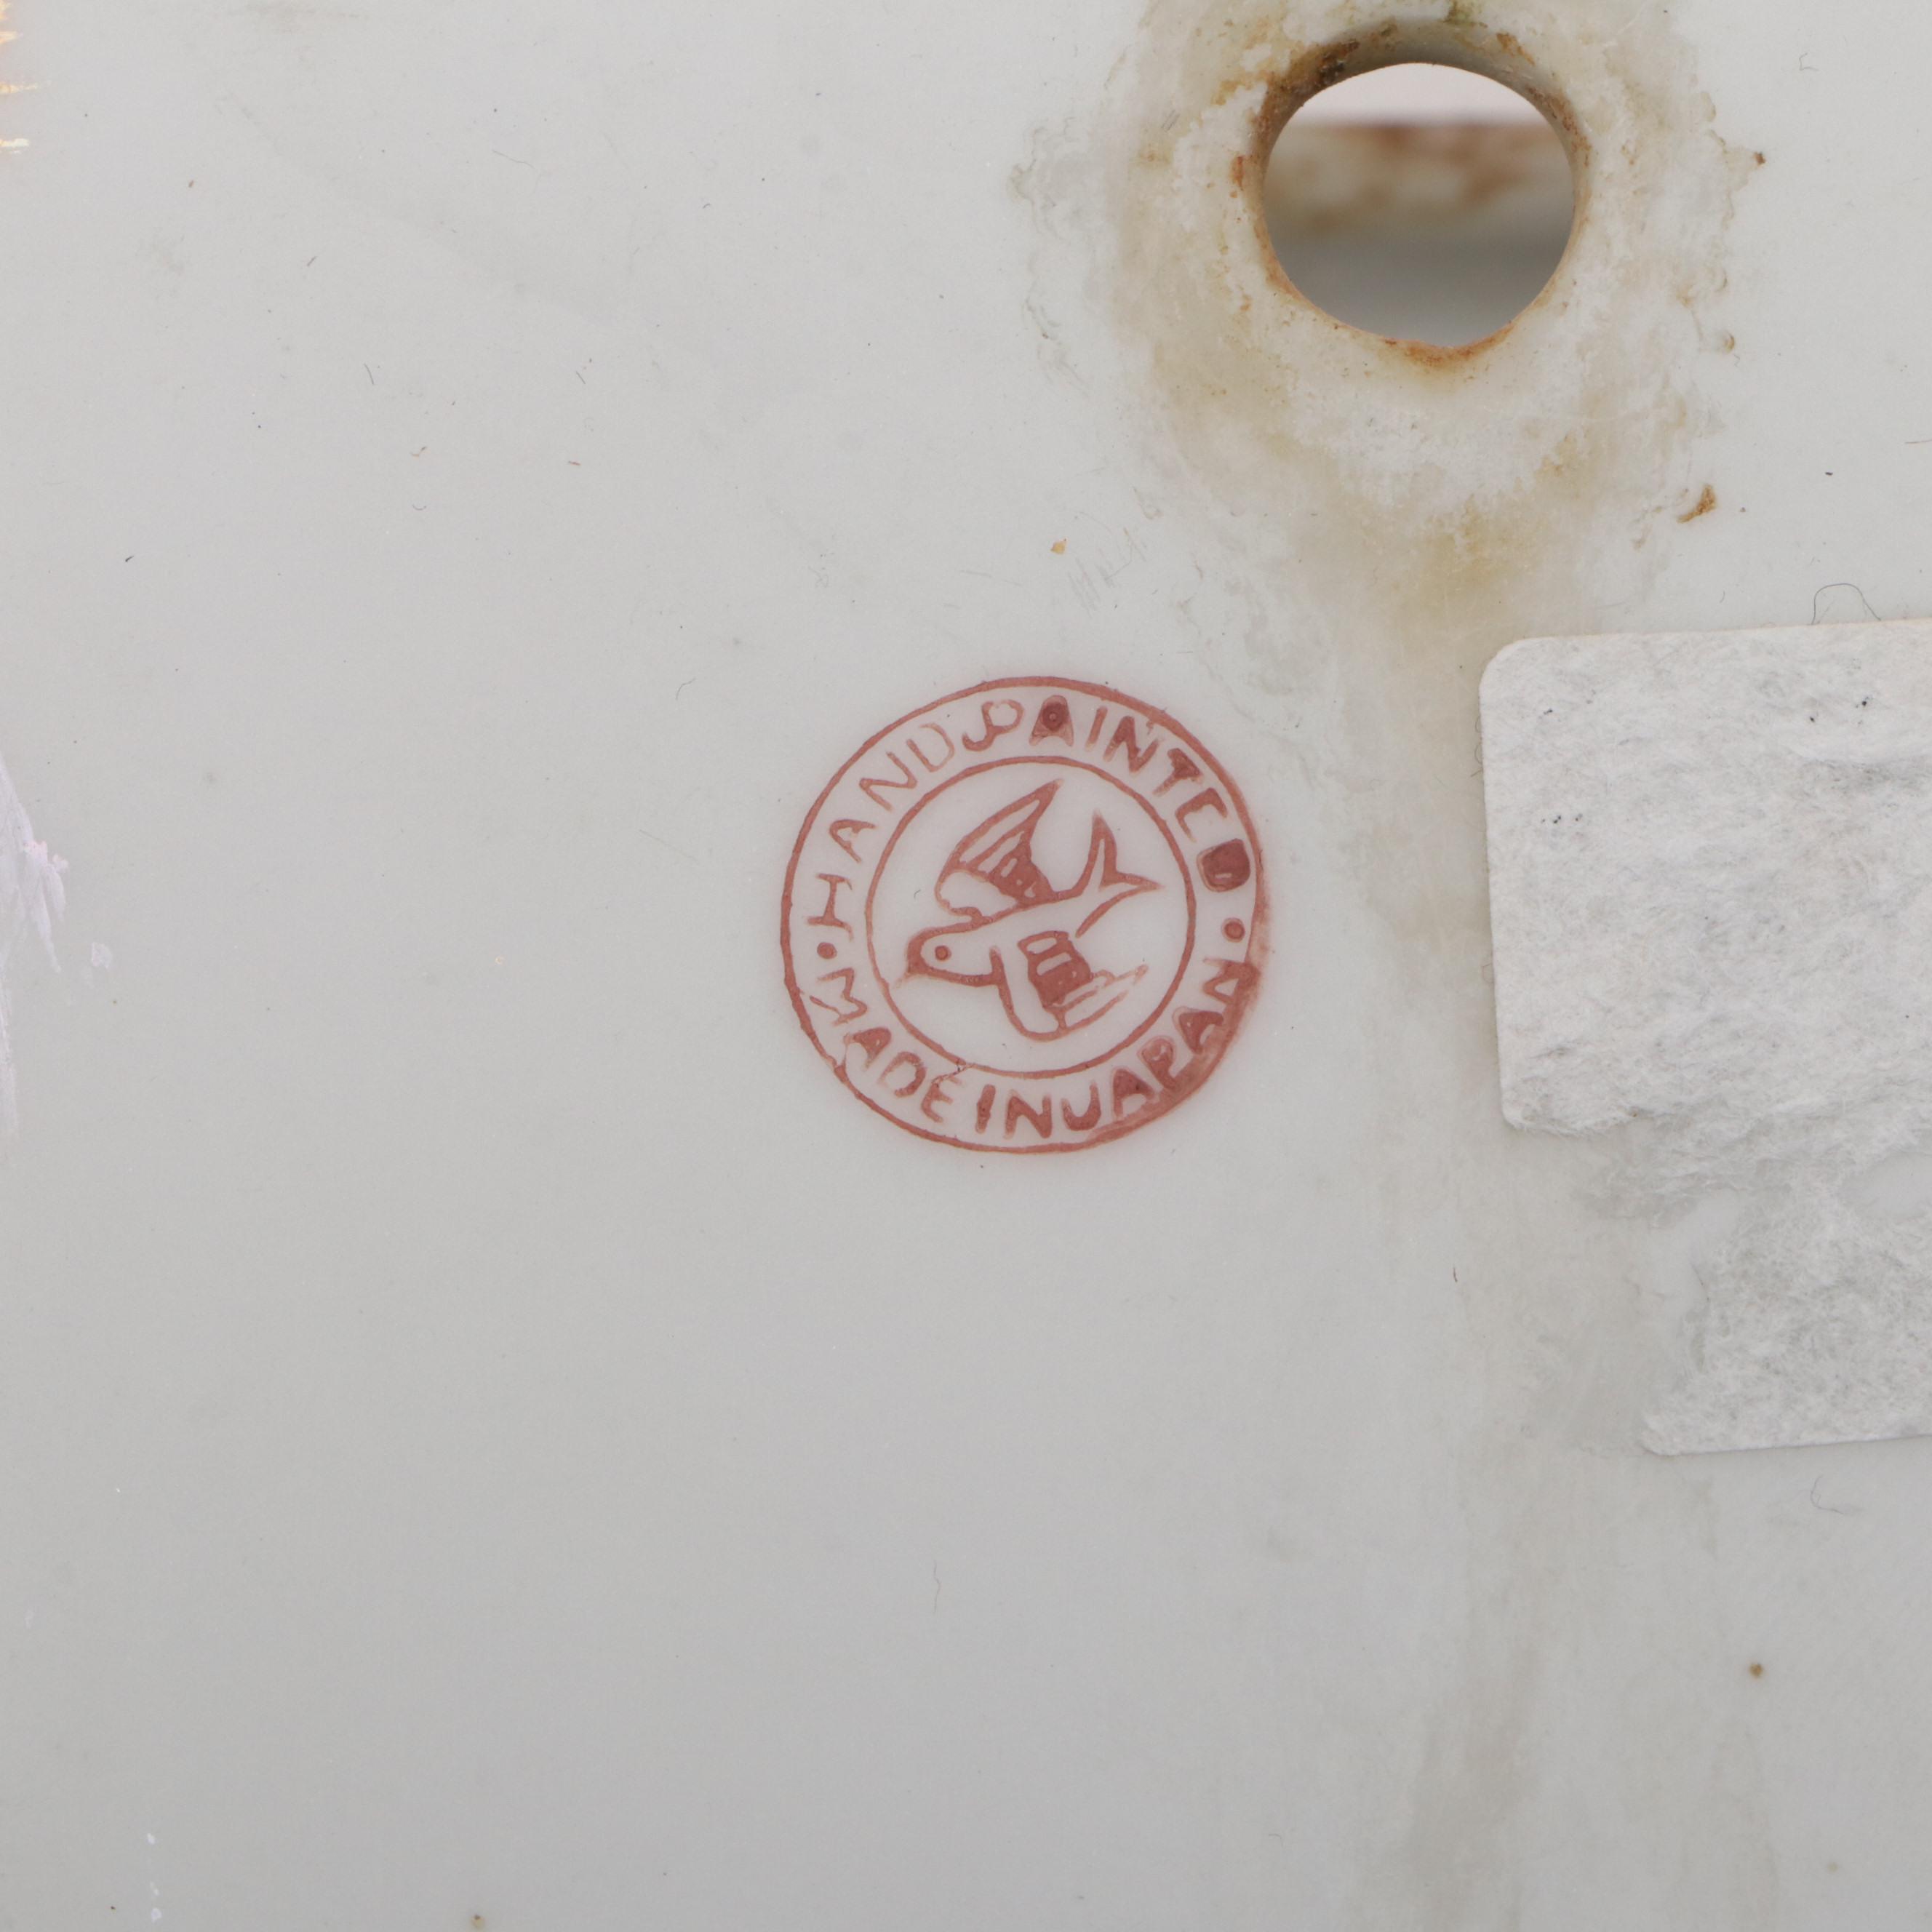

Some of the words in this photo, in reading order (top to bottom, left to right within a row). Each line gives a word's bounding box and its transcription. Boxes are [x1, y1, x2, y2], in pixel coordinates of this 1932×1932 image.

[807, 723, 954, 941] HAND
[962, 695, 1251, 892] PAINTED
[809, 967, 962, 1122] MADE
[975, 1084, 1053, 1138] IN
[1061, 957, 1259, 1130] JAPAN
